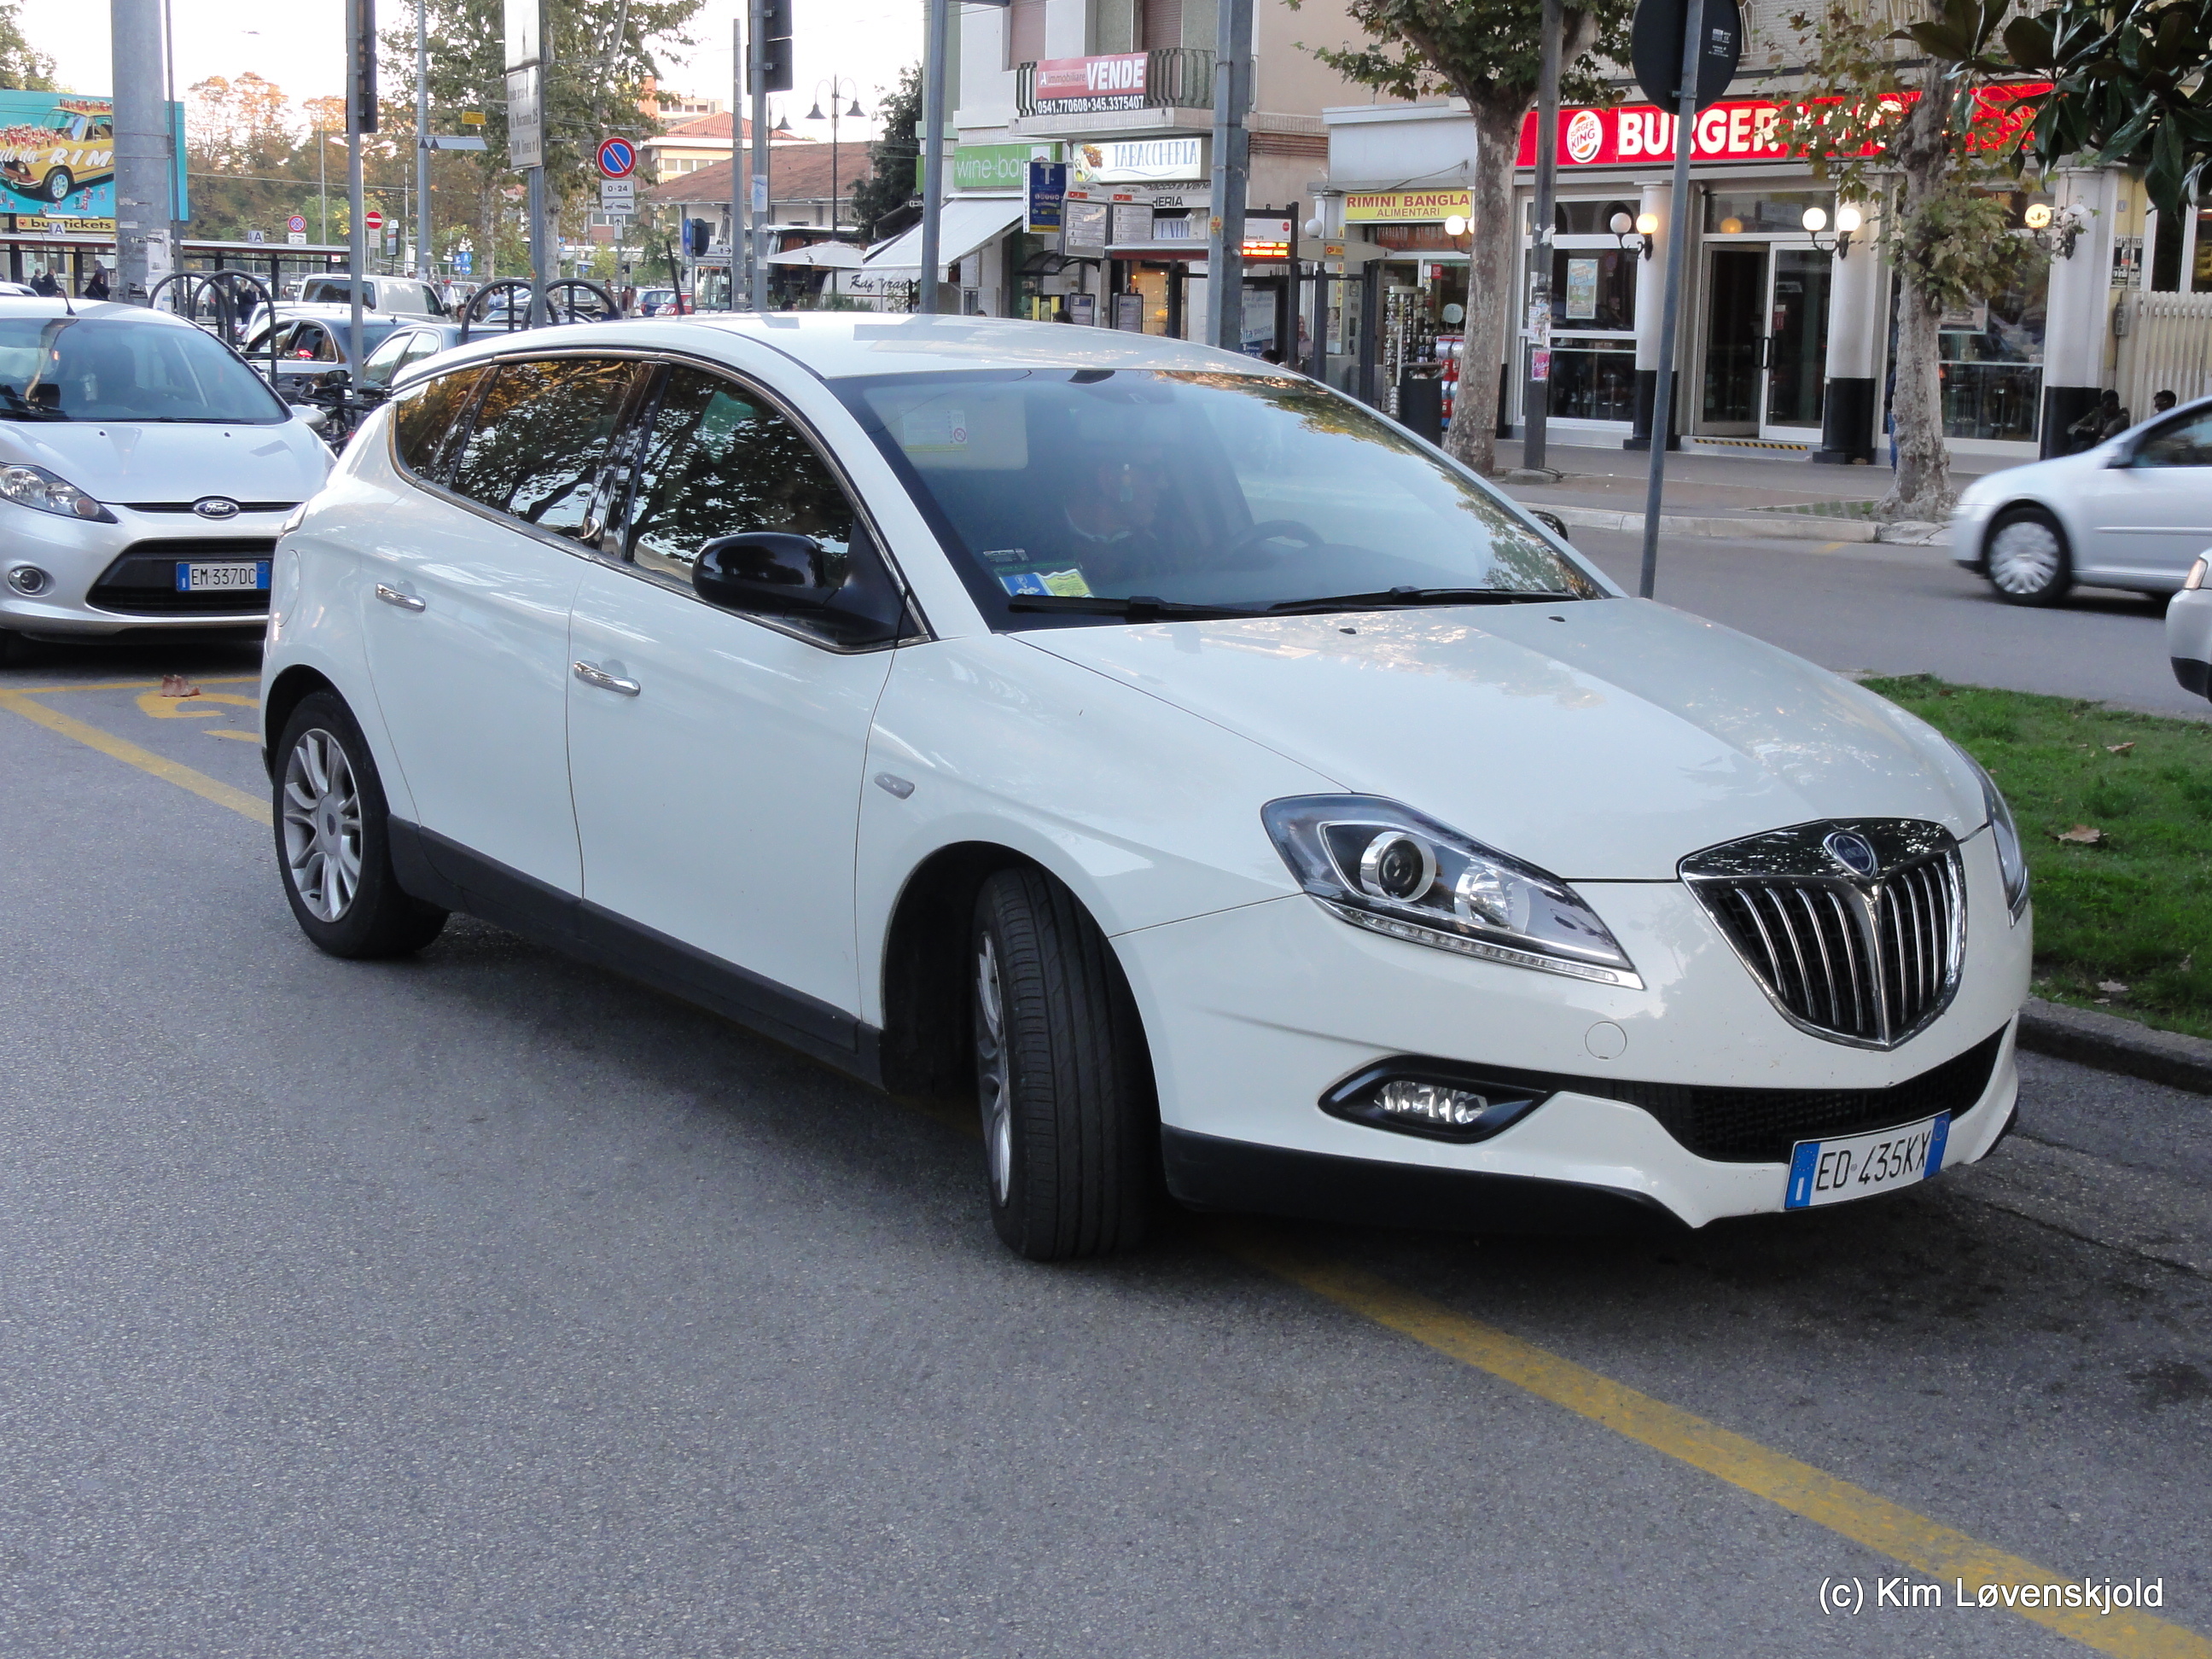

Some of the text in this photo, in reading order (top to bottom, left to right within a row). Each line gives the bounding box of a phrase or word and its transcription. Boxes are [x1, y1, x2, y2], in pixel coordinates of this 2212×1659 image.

[1048, 73, 1086, 84] immobiliare
[1086, 59, 1144, 90] VENDE
[1571, 128, 1595, 152] KING
[49, 148, 114, 167] RIM
[1113, 141, 1198, 167] TABACCHERIA
[957, 154, 1024, 178] wine-bar
[1152, 196, 1184, 207] HERIA
[1347, 194, 1470, 207] RIMINI BANGLA
[1377, 207, 1441, 218] ALIMENTARI
[31, 218, 112, 230] bu tickets
[55, 226, 64, 235] A
[254, 231, 263, 242] A
[205, 502, 230, 513] Ford
[191, 568, 256, 585] EM 337DC
[1815, 1130, 1931, 1191] ED 435KX
